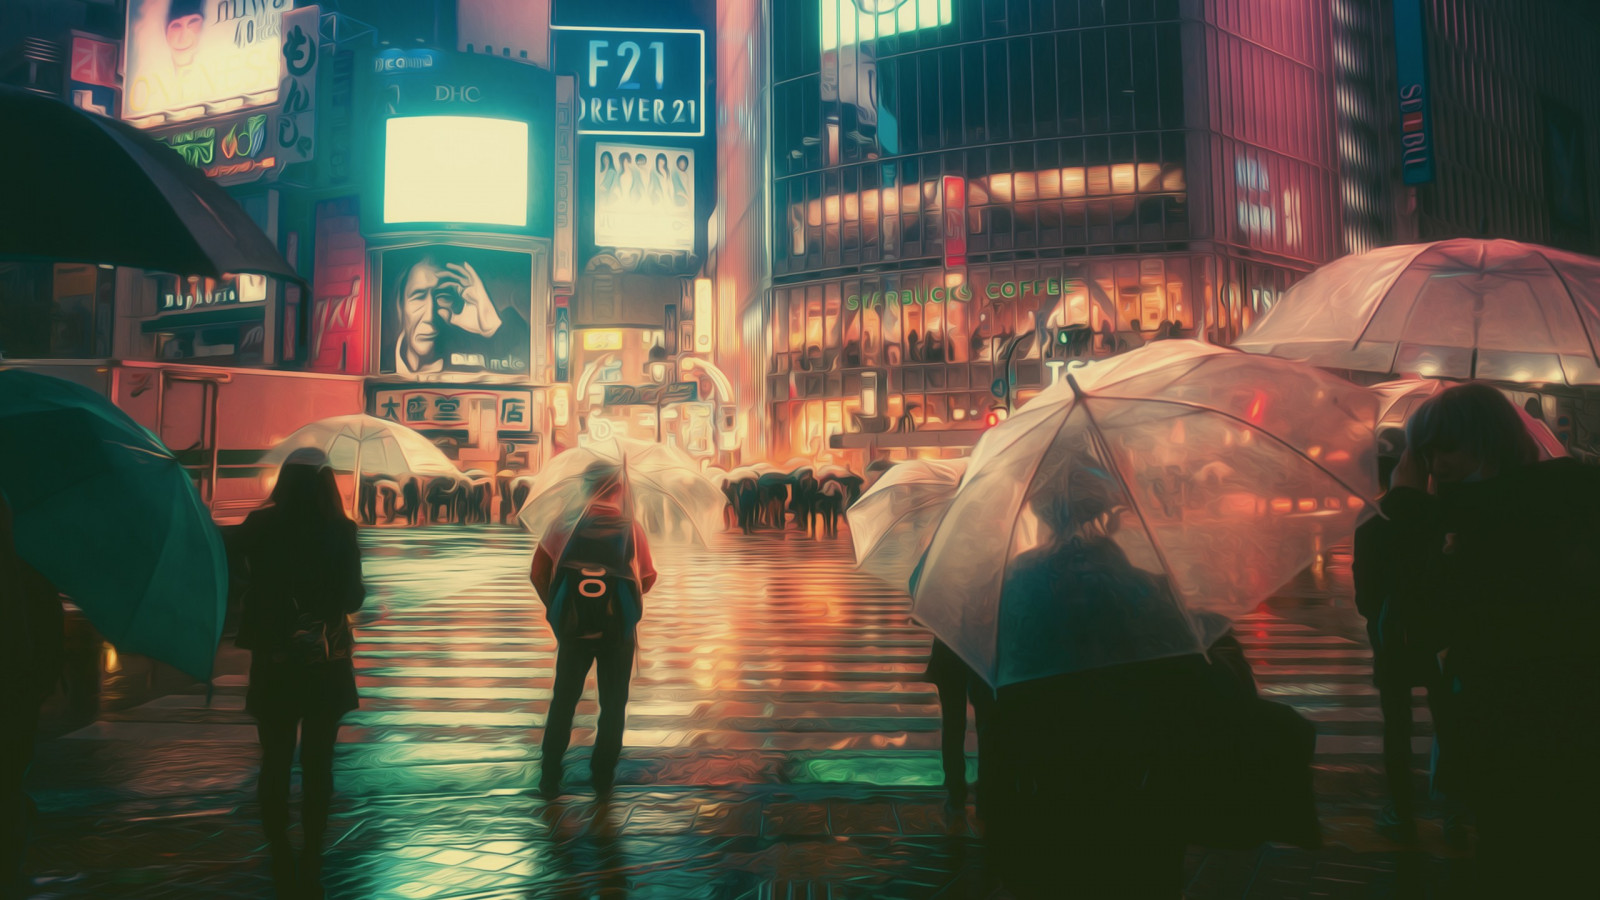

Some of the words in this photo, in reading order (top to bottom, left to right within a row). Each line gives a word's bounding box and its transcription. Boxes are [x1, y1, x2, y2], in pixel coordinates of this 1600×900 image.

[588, 40, 664, 90] F21
[434, 84, 481, 103] DHC
[671, 99, 696, 125] 21
[846, 283, 973, 311] STARBUCKS
[986, 278, 1077, 300] COFFEE
